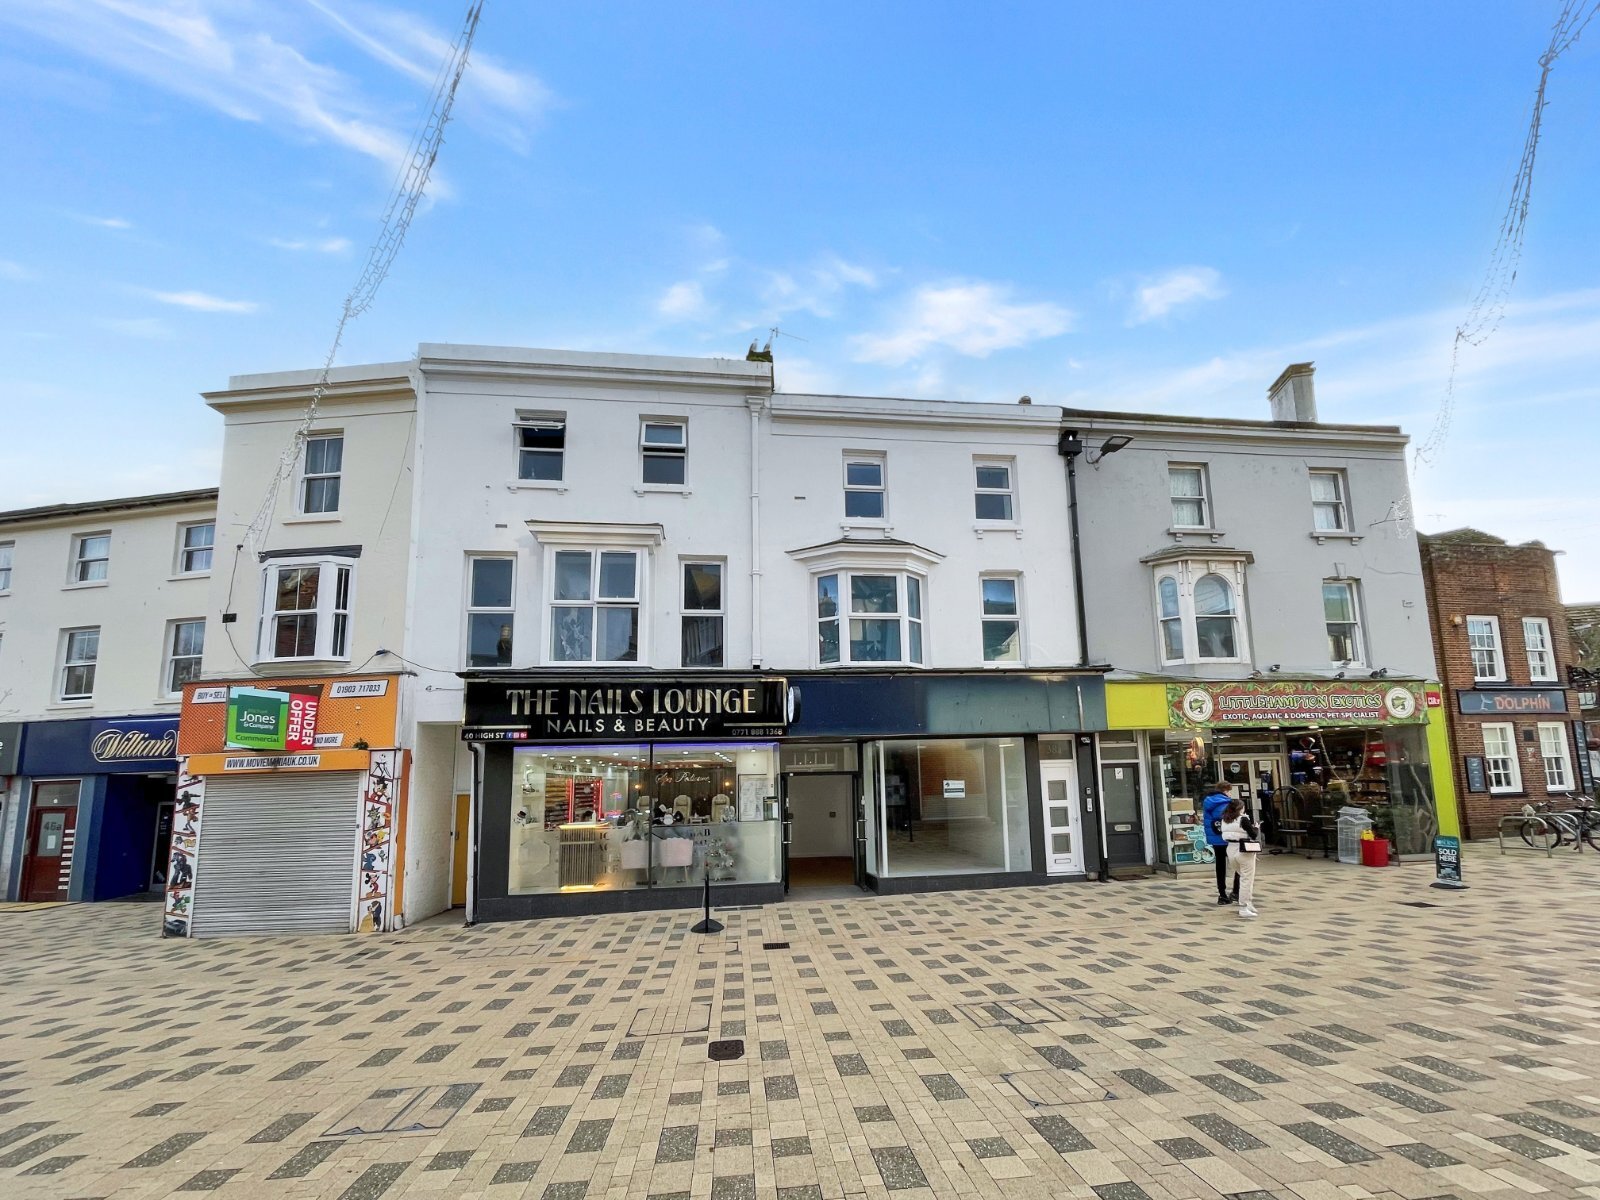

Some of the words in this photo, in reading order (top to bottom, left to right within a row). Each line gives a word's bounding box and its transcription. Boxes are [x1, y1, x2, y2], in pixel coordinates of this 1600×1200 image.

[506, 689, 560, 715] THE
[568, 689, 644, 715] NAILS
[653, 688, 756, 714] LOUNGE
[1218, 695, 1328, 710] LITTLEHAMPTON
[1330, 694, 1382, 709] EXOTICS
[1494, 694, 1551, 710] DOLPHIN
[240, 711, 276, 724] Jones
[287, 700, 303, 741] OFFER
[301, 701, 317, 745] UNDER
[547, 719, 605, 733] NAILS
[613, 718, 626, 732] &
[634, 718, 709, 732] BEAUTY
[91, 728, 177, 759] William
[235, 734, 280, 743] Commercial
[324, 736, 338, 744] MORE
[1438, 848, 1457, 856] SOLD
[1438, 855, 1457, 863] HERE
